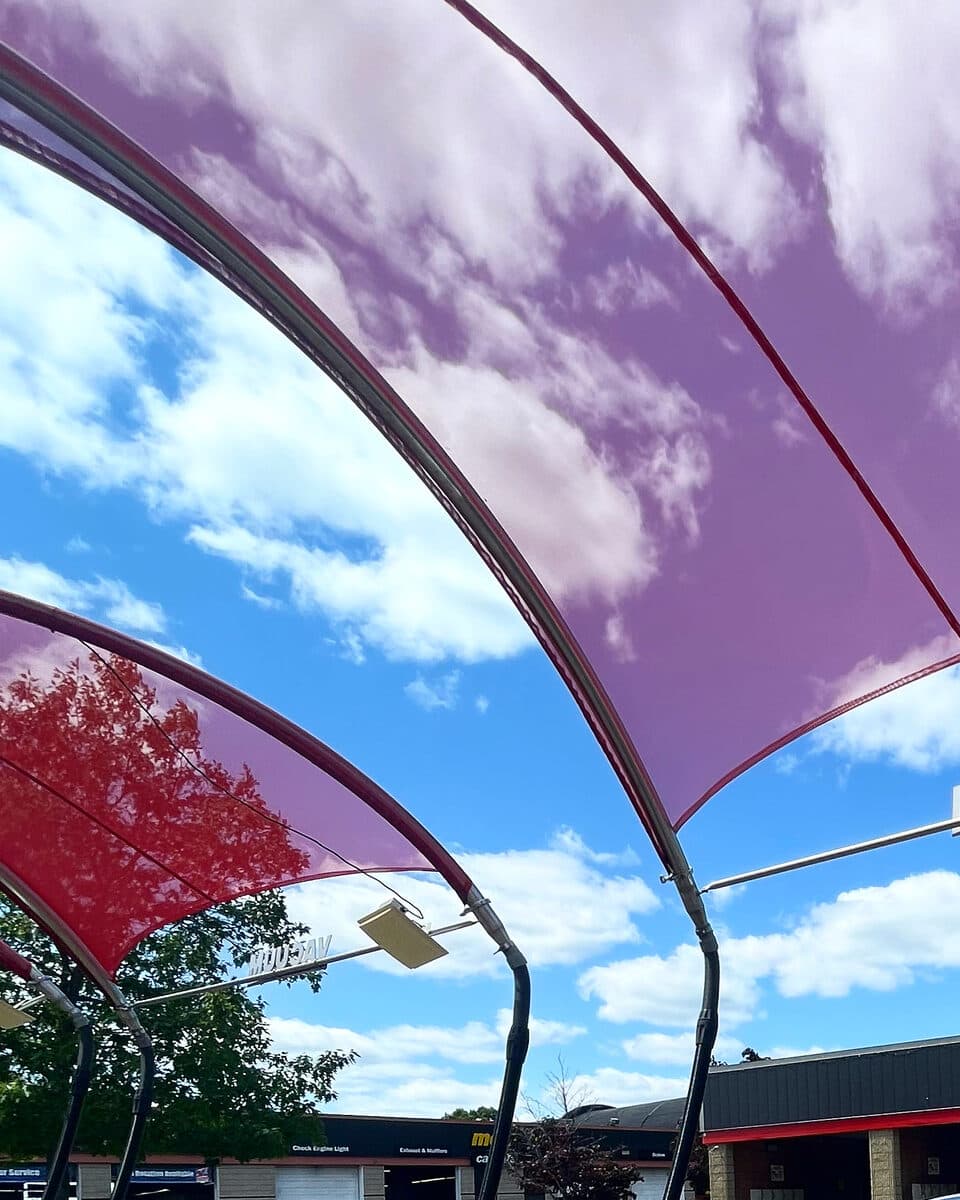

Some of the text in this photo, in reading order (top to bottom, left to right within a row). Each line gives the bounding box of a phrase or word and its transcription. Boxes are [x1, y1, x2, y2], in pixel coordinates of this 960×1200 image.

[292, 1144, 312, 1152] Check
[334, 1145, 349, 1153] Light
[8, 1168, 40, 1177] Service
